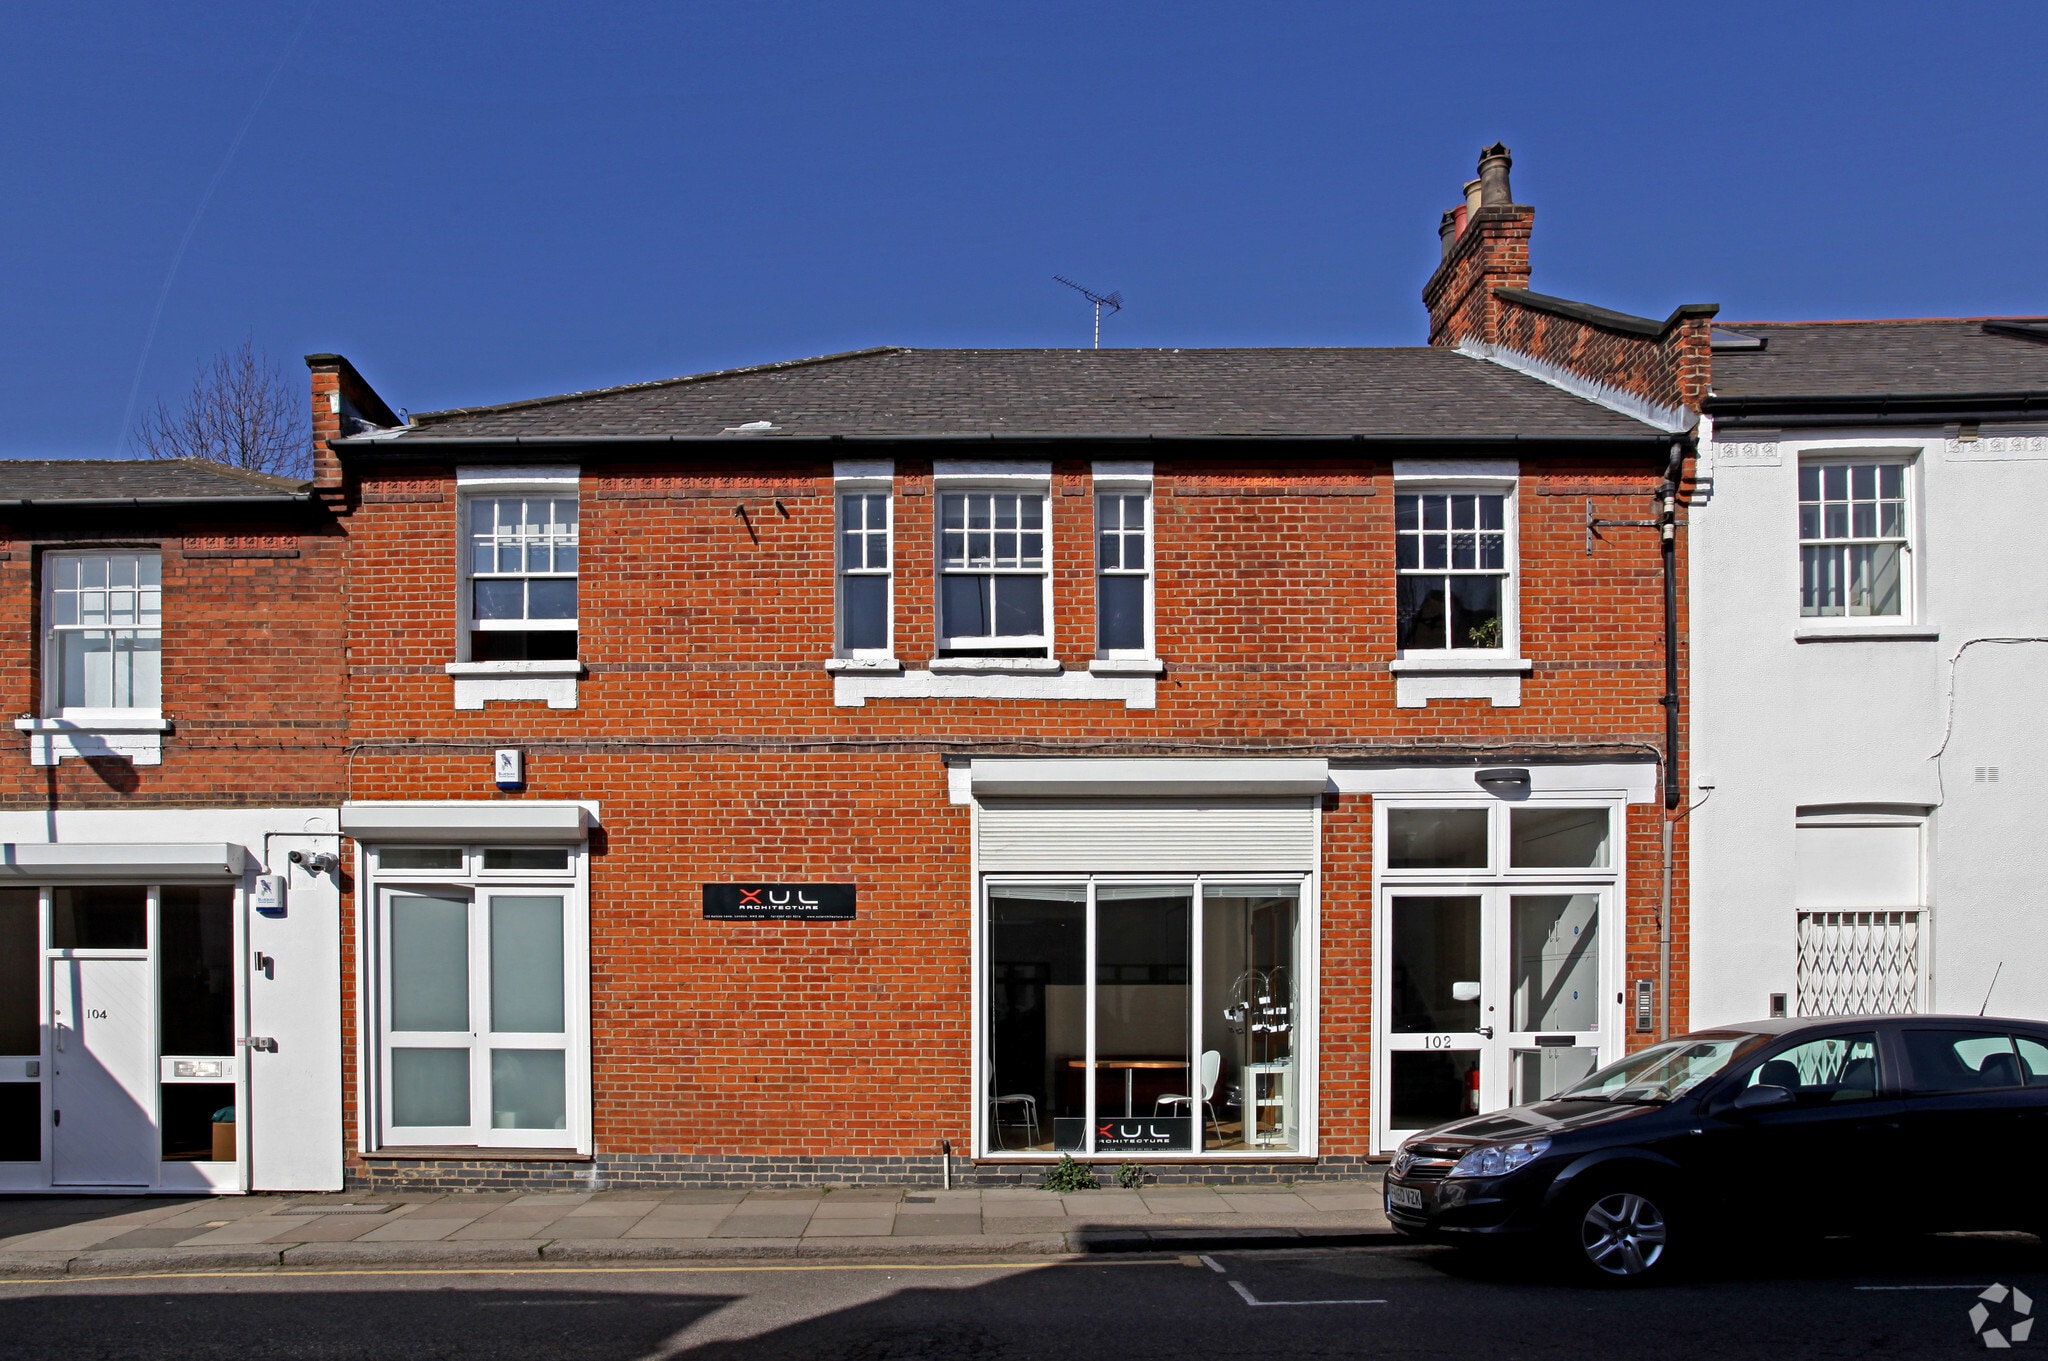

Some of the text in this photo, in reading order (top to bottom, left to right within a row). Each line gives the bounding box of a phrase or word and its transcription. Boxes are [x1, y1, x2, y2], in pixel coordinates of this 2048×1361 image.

[739, 888, 819, 904] XUL
[87, 1009, 107, 1019] 104
[1424, 1035, 1451, 1049] 102
[1095, 1123, 1170, 1138] XUL
